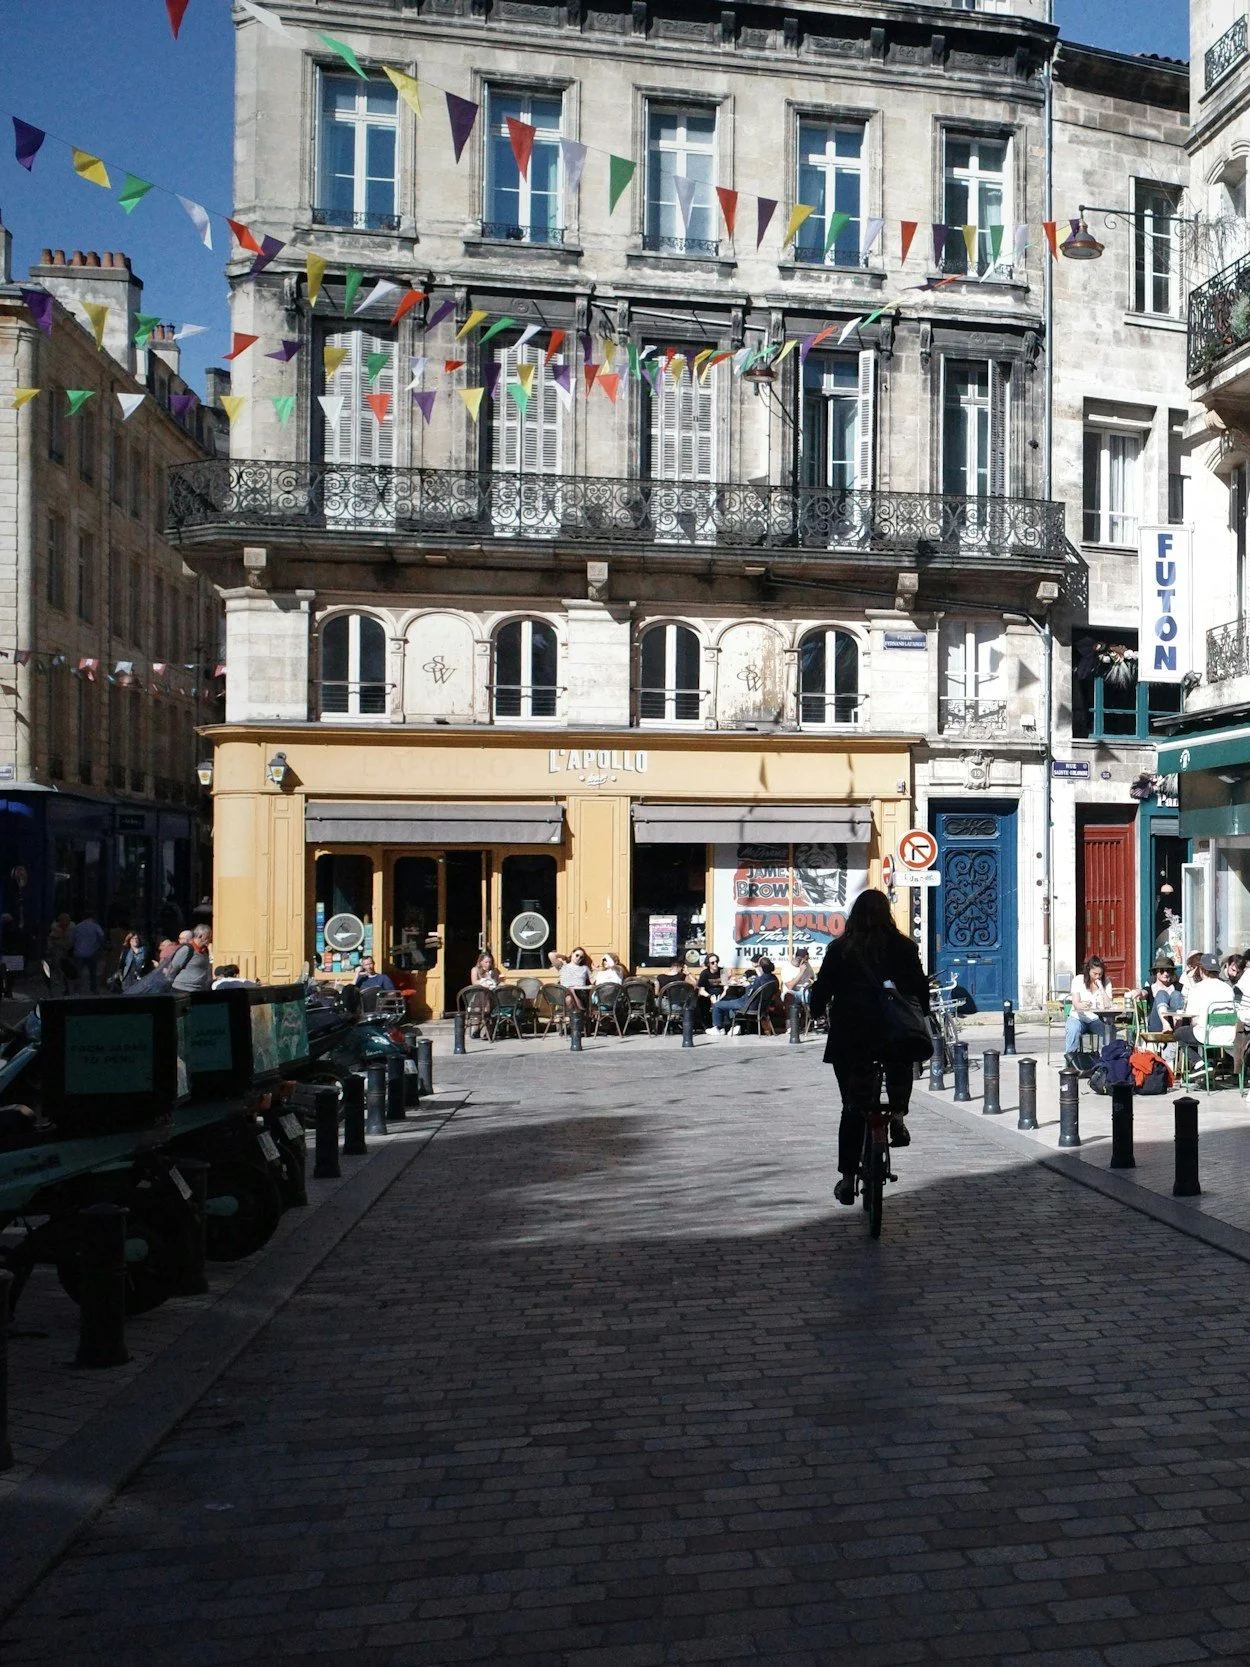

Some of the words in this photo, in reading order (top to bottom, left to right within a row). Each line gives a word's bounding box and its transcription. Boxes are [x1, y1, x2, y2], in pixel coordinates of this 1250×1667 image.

[1154, 533, 1177, 671] FUTON
[548, 750, 648, 774] L'APOLLO
[737, 880, 800, 897] BROWN
[768, 912, 847, 937] APOLLO
[735, 947, 773, 957] THUR.
